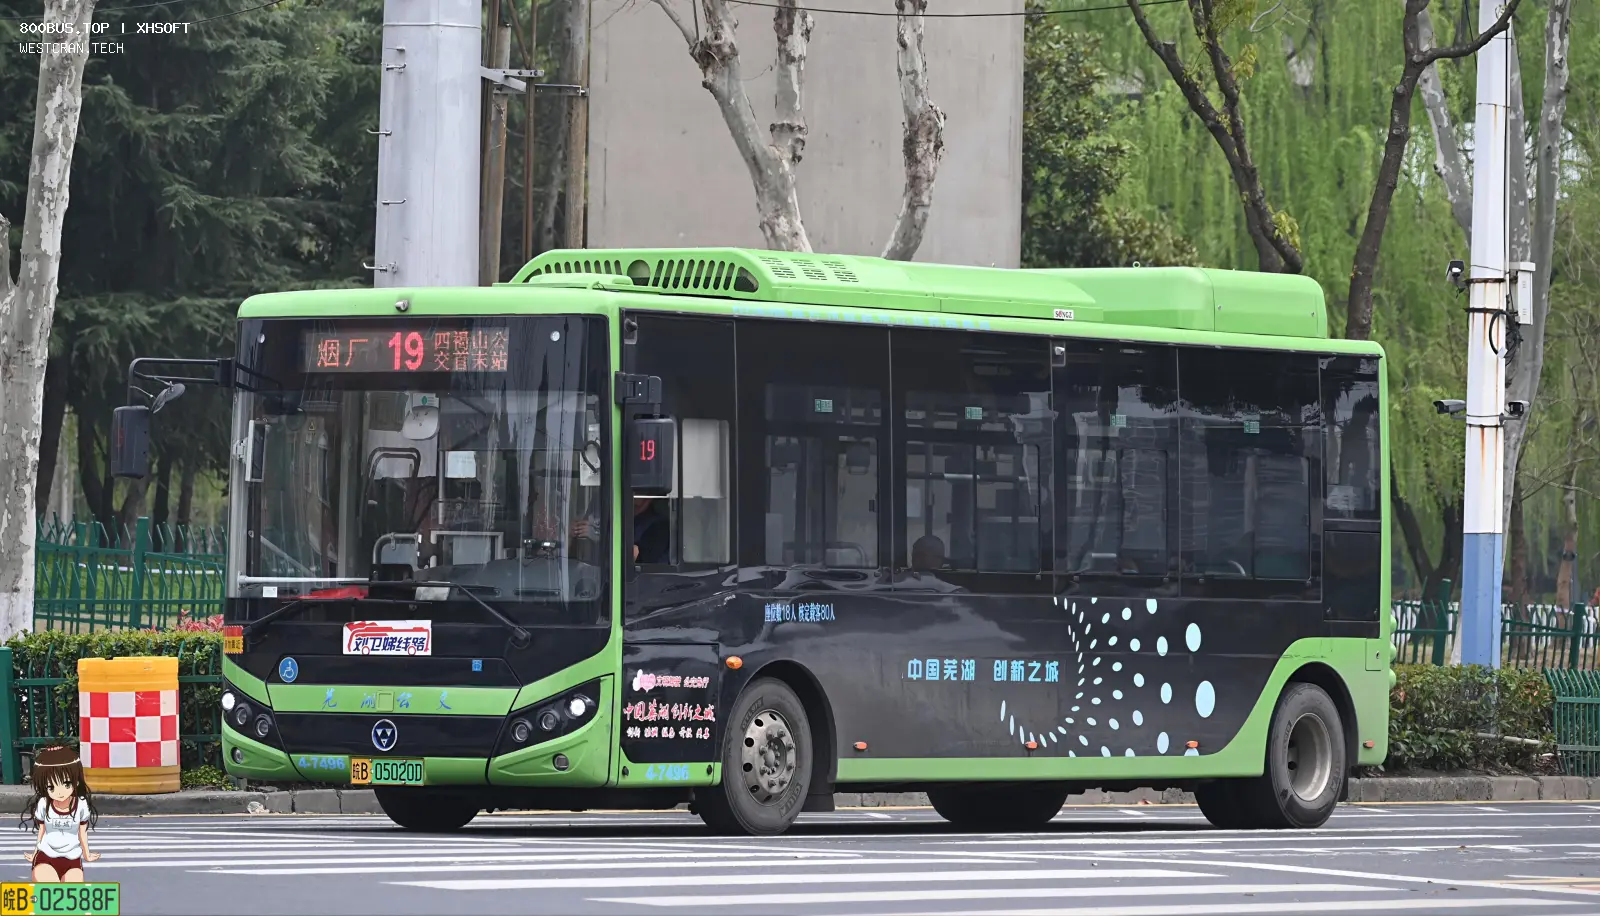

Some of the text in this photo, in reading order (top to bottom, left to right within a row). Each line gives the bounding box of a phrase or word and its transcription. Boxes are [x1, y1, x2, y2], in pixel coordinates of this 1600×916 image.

[388, 331, 424, 370] 19
[434, 330, 508, 350] 四褐山公
[317, 339, 369, 367] 烟厂
[434, 350, 508, 371] 交首末站
[640, 439, 655, 461] 19
[907, 658, 1059, 682] 中国芜湖 创新之城
[298, 756, 346, 770] 4-7496
